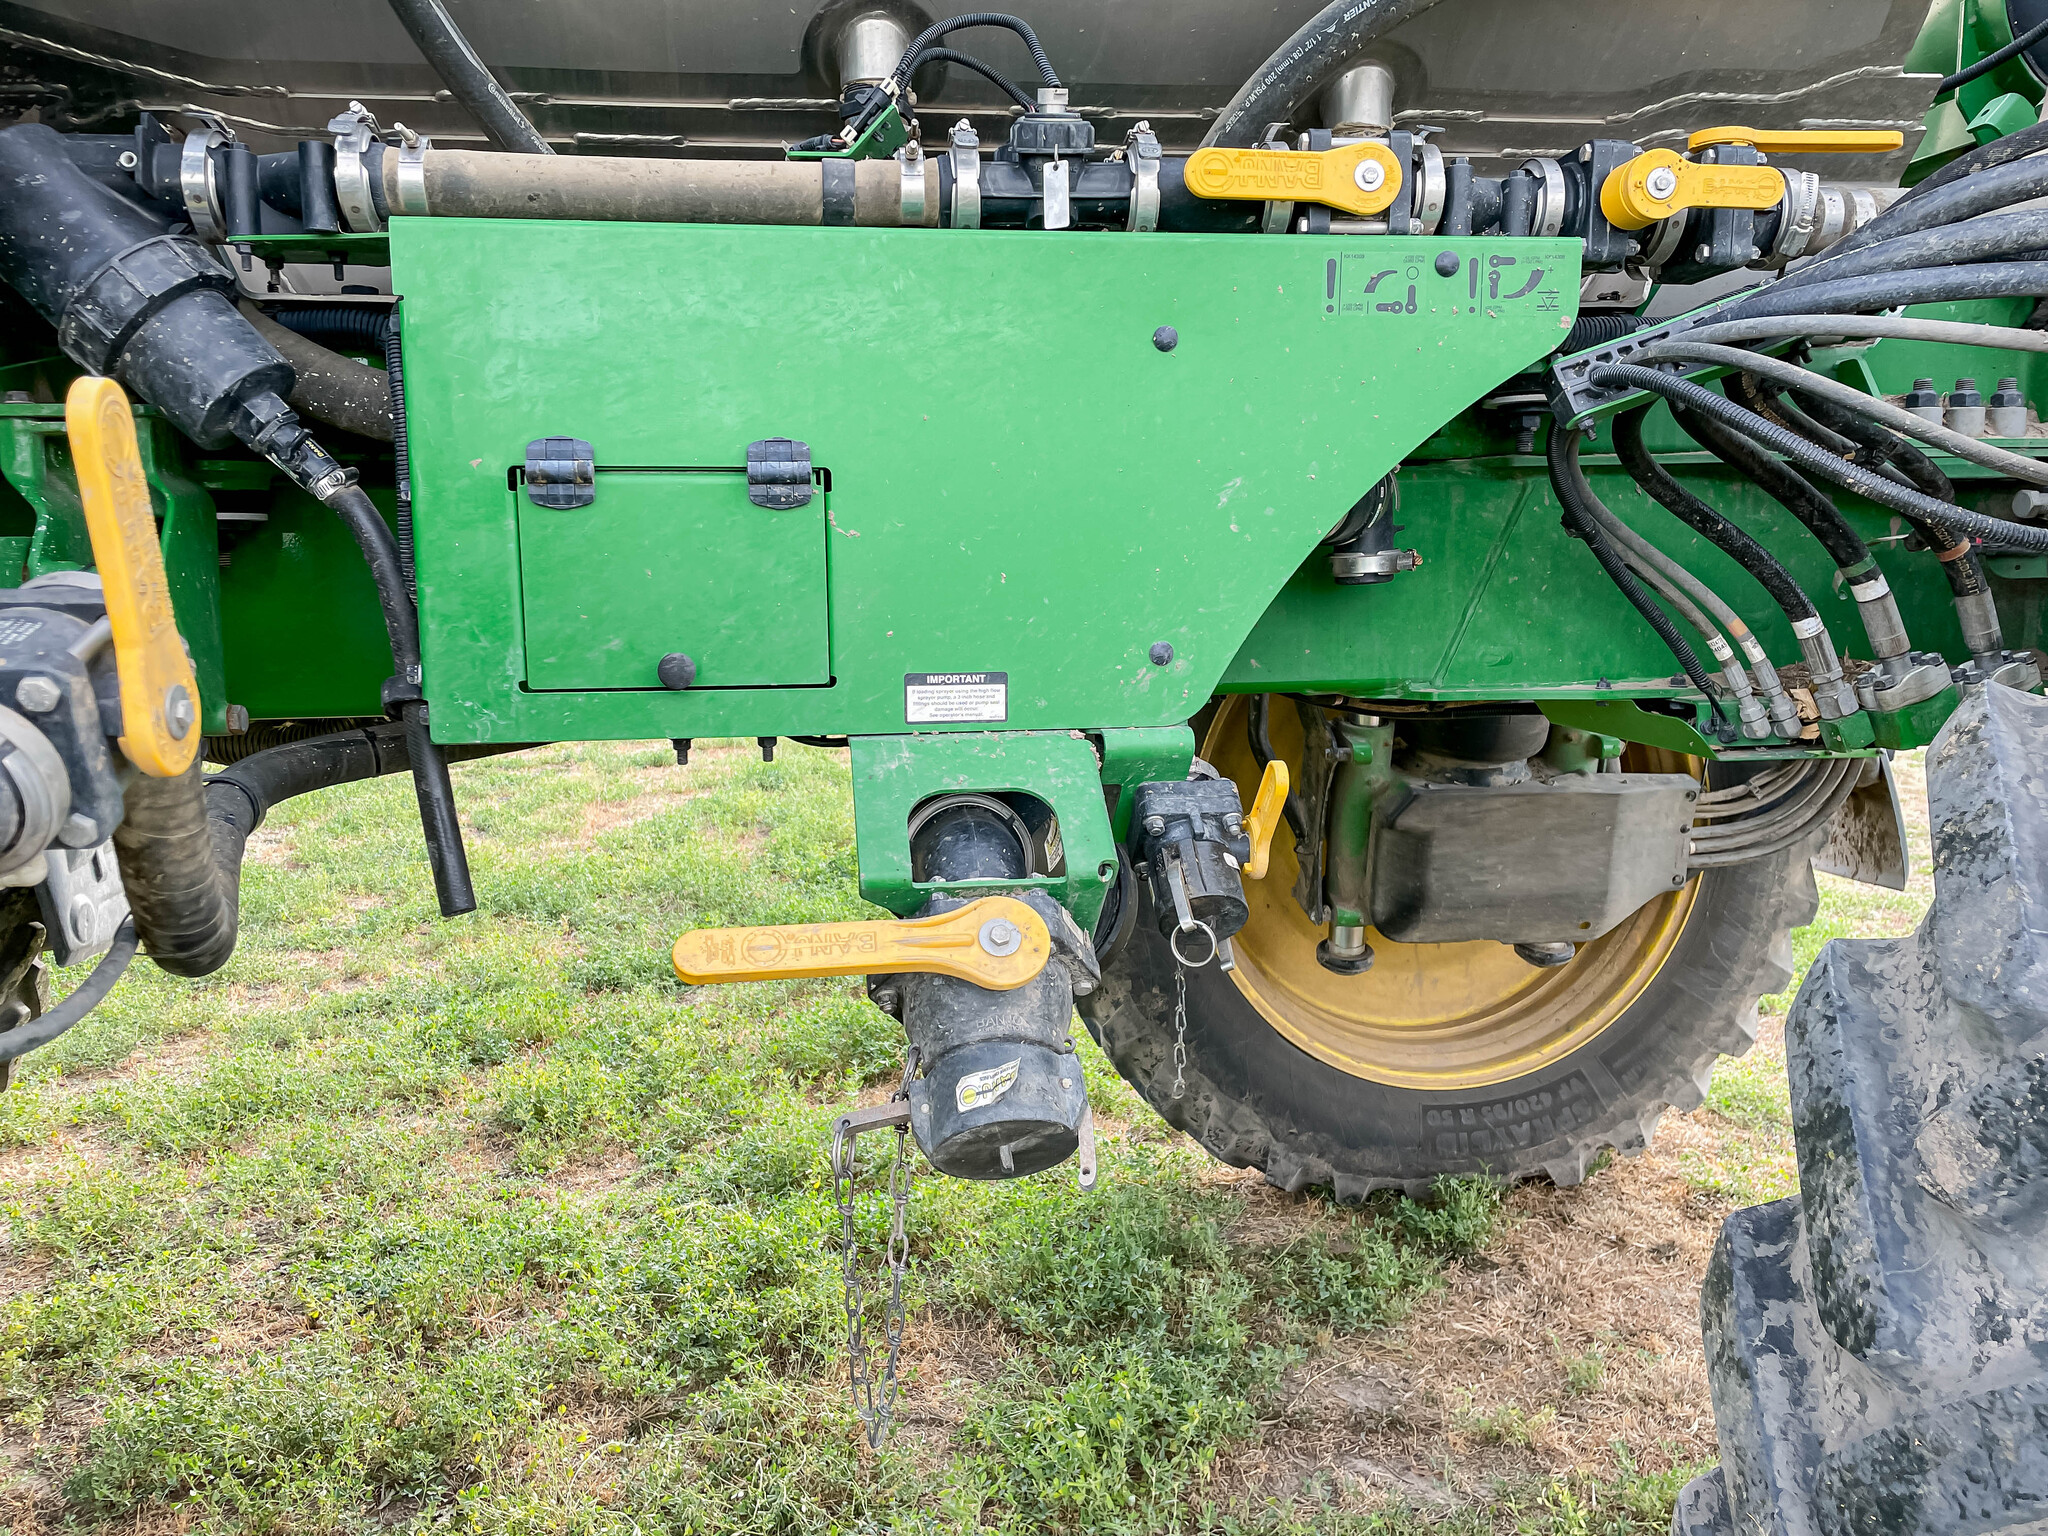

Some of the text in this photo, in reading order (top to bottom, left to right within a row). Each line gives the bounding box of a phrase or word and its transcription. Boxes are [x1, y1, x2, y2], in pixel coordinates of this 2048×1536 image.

[1342, 0, 1380, 24] ONTIER
[1274, 46, 1304, 75] (38.1mm)
[1264, 71, 1278, 85] 200
[926, 674, 987, 684] IMPORTANT
[976, 1014, 1026, 1028] BANJO
[1426, 1109, 1454, 1127] 50
[1459, 1108, 1477, 1125] R
